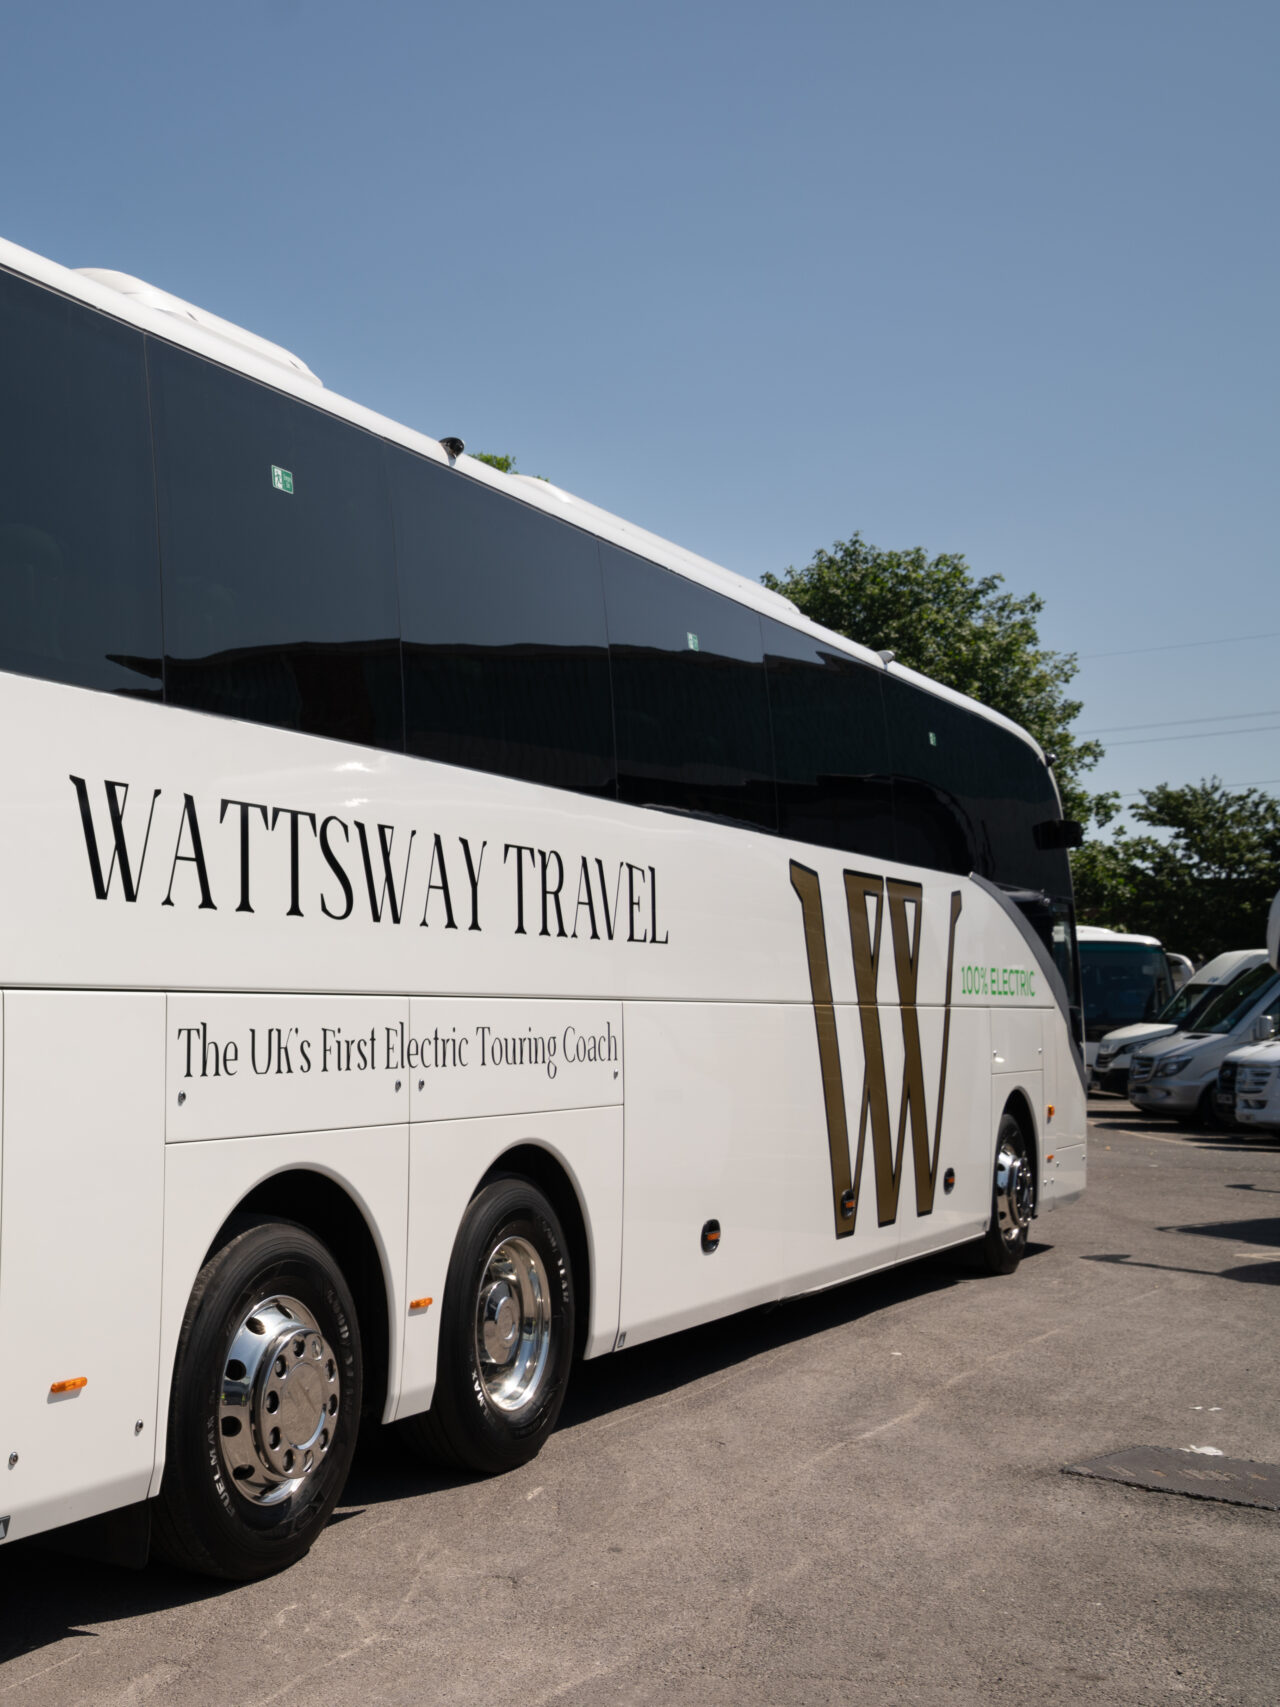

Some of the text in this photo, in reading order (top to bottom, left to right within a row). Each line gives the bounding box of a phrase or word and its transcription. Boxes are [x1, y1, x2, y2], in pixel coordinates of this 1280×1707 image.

[69, 774, 669, 945] WATTSWAY TRAVEL
[961, 966, 1036, 997] 100% ELECTRIC
[177, 1021, 618, 1080] The UK's First Electric Touring Coach
